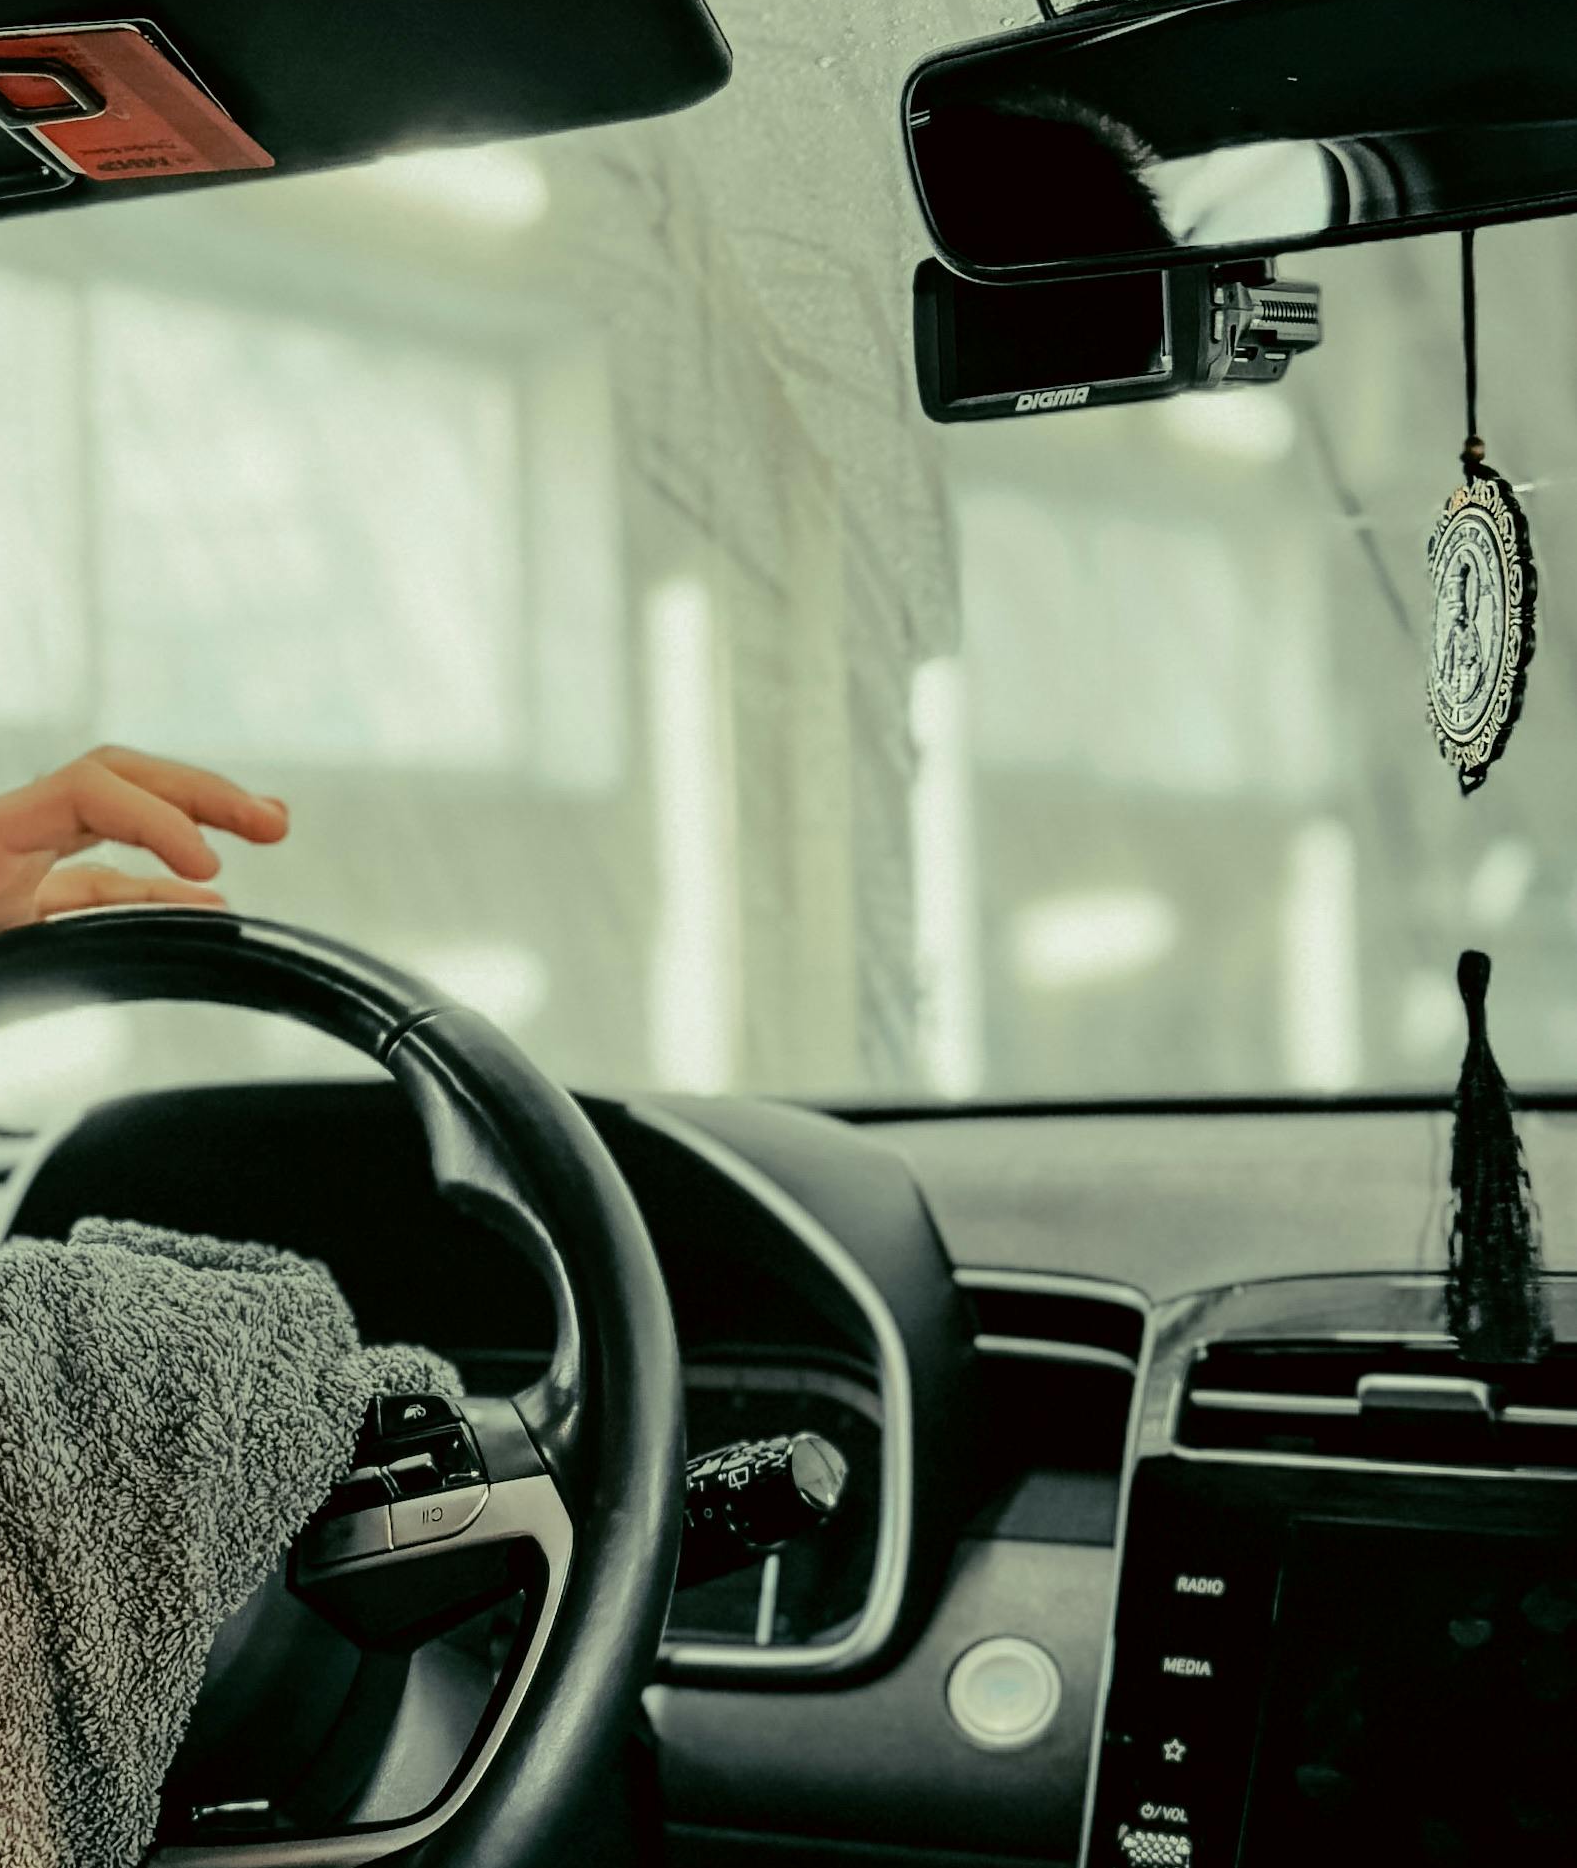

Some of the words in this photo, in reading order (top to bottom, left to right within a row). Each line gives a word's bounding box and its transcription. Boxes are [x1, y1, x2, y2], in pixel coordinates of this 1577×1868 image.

[1015, 386, 1091, 412] DIGMA
[1176, 1575, 1226, 1596] RADIO
[1163, 1657, 1213, 1677] MEDIA
